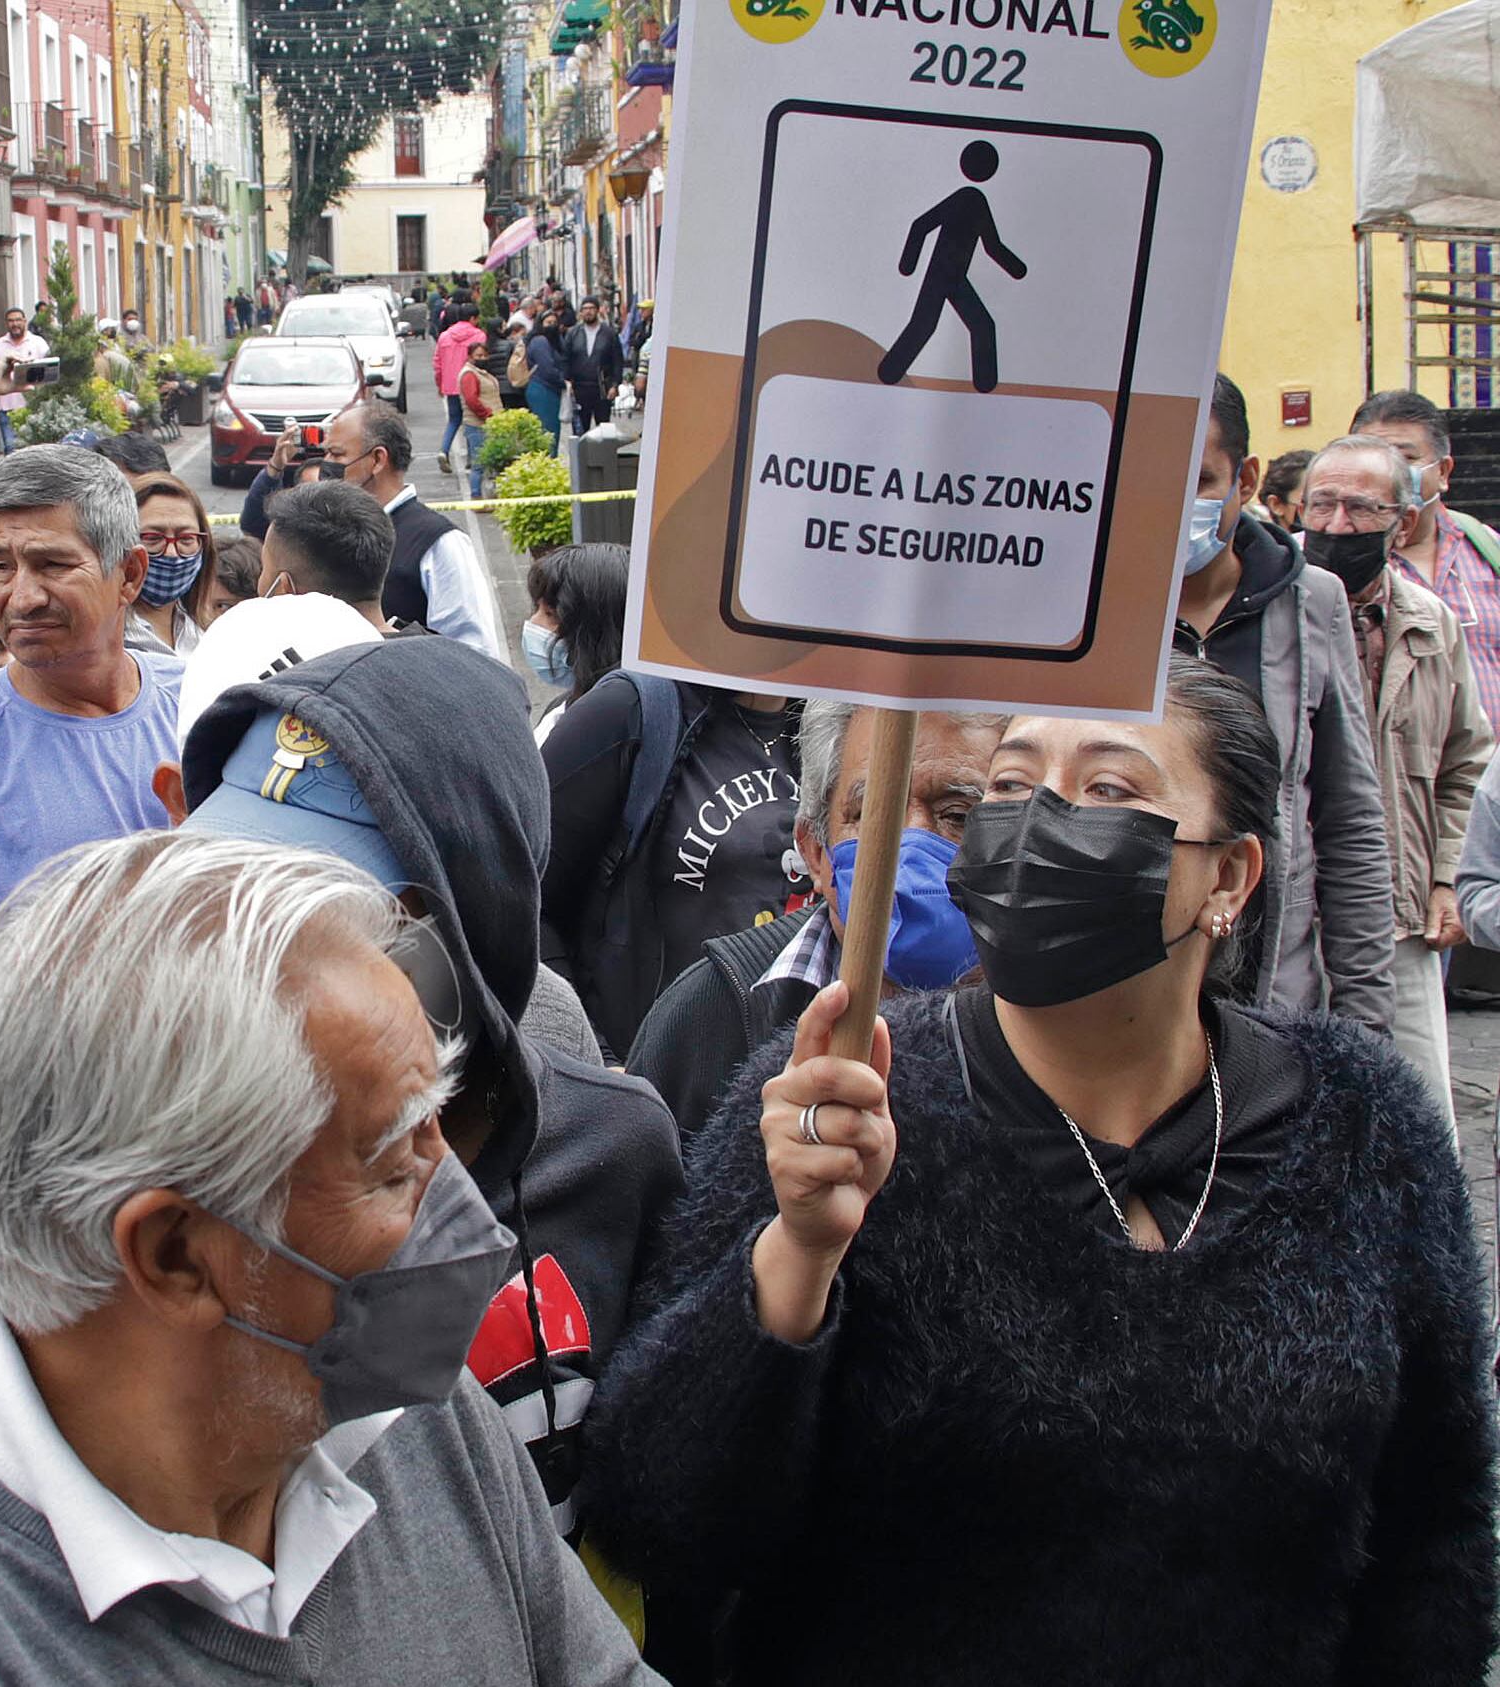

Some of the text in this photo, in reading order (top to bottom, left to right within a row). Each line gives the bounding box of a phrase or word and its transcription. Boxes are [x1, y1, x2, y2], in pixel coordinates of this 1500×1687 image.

[909, 41, 1027, 91] 2022
[759, 454, 1094, 513] ACUDE A LAS ZONAS
[804, 518, 1044, 567] DE SEGURIDAD
[673, 768, 778, 892] MICKEY
